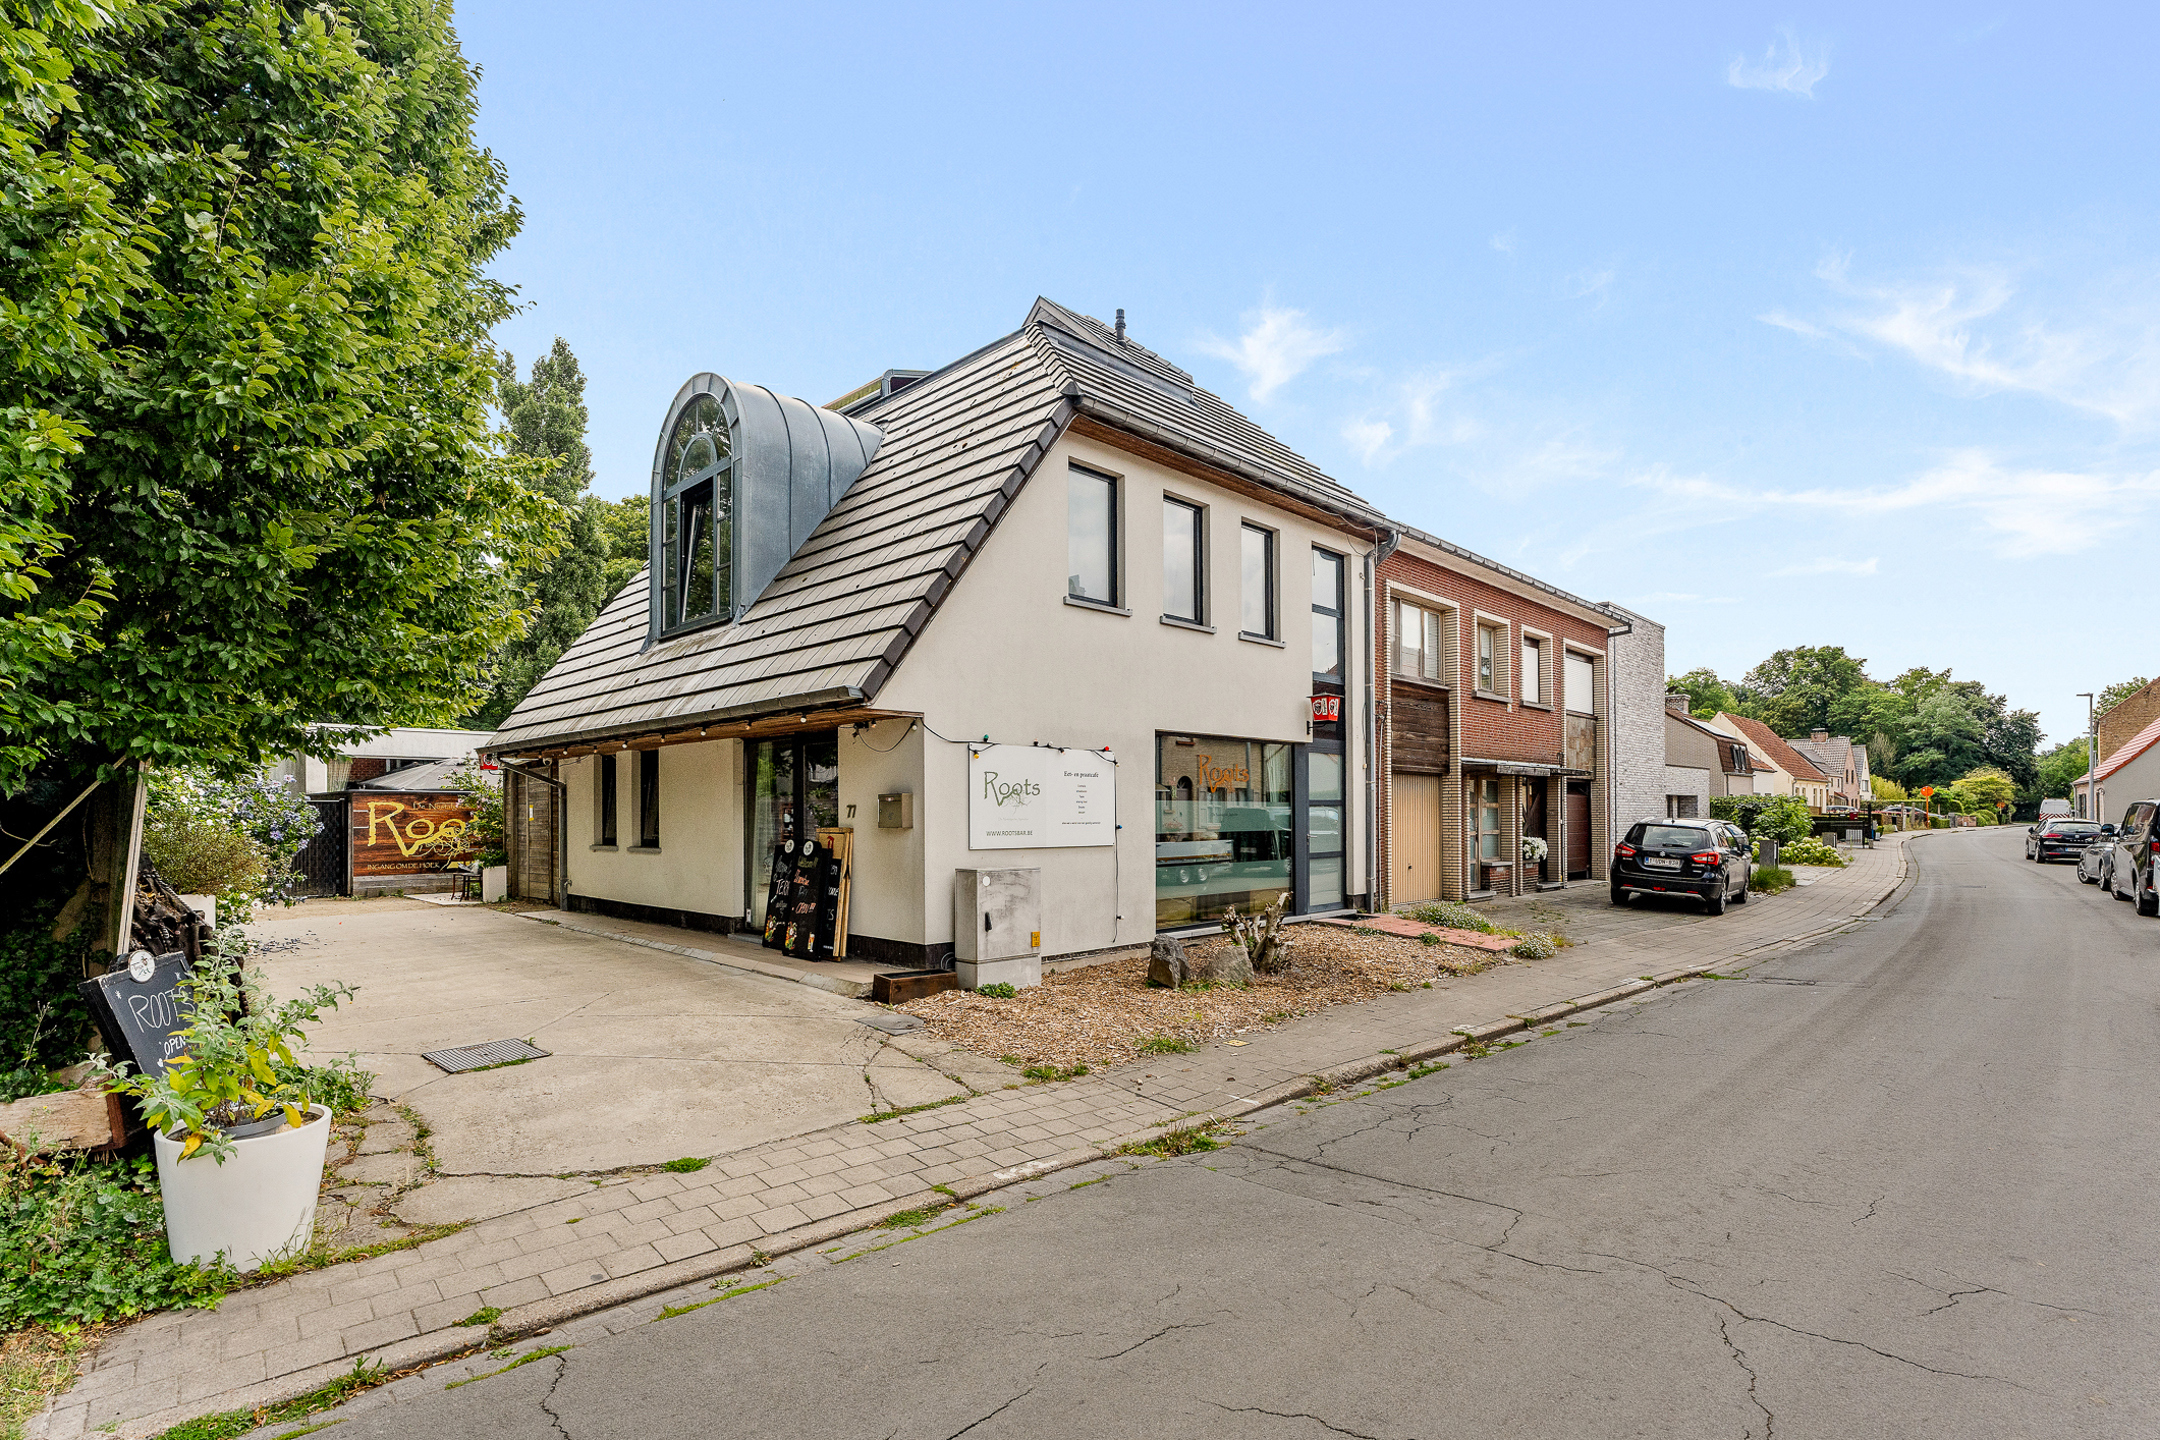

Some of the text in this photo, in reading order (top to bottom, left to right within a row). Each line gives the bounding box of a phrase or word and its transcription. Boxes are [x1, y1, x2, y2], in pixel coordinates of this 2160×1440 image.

[984, 771, 1041, 807] Roots
[1197, 754, 1250, 793] Roots
[367, 801, 482, 857] Roo
[128, 985, 197, 1033] ROOTS
[164, 1035, 186, 1056] OPEN
